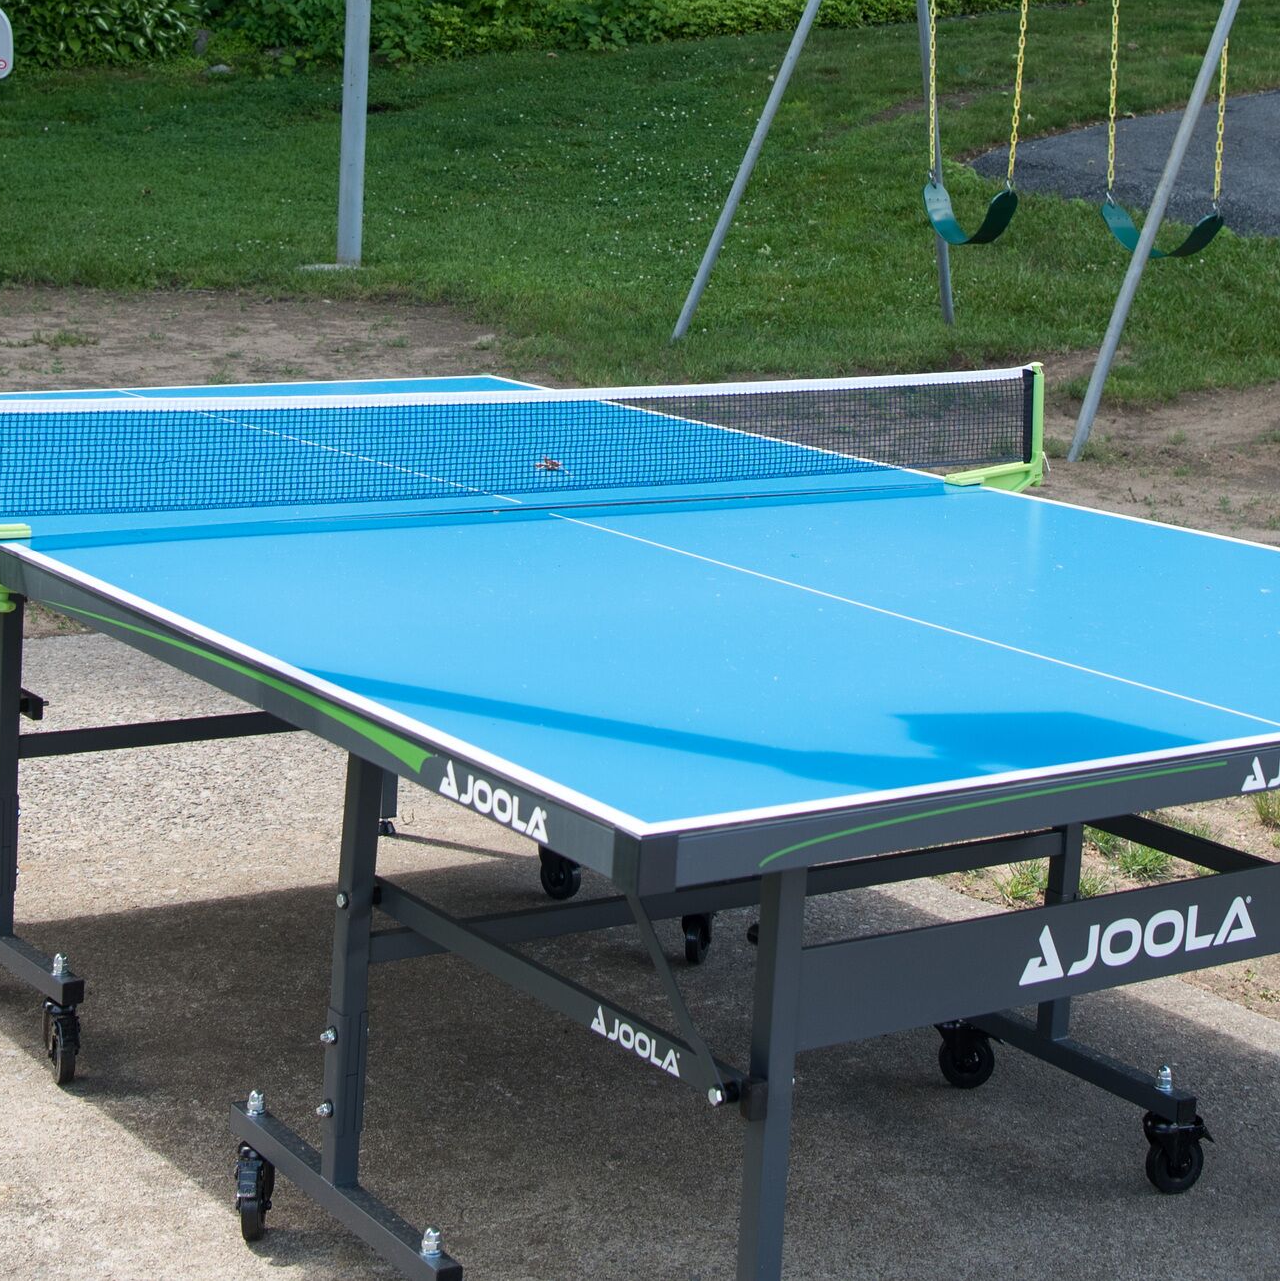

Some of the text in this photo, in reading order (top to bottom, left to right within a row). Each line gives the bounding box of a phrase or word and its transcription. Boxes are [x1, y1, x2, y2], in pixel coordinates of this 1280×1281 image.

[459, 774, 549, 844] JOOLA
[1067, 896, 1257, 976] JOOLA
[607, 1018, 680, 1078] JOOLA
